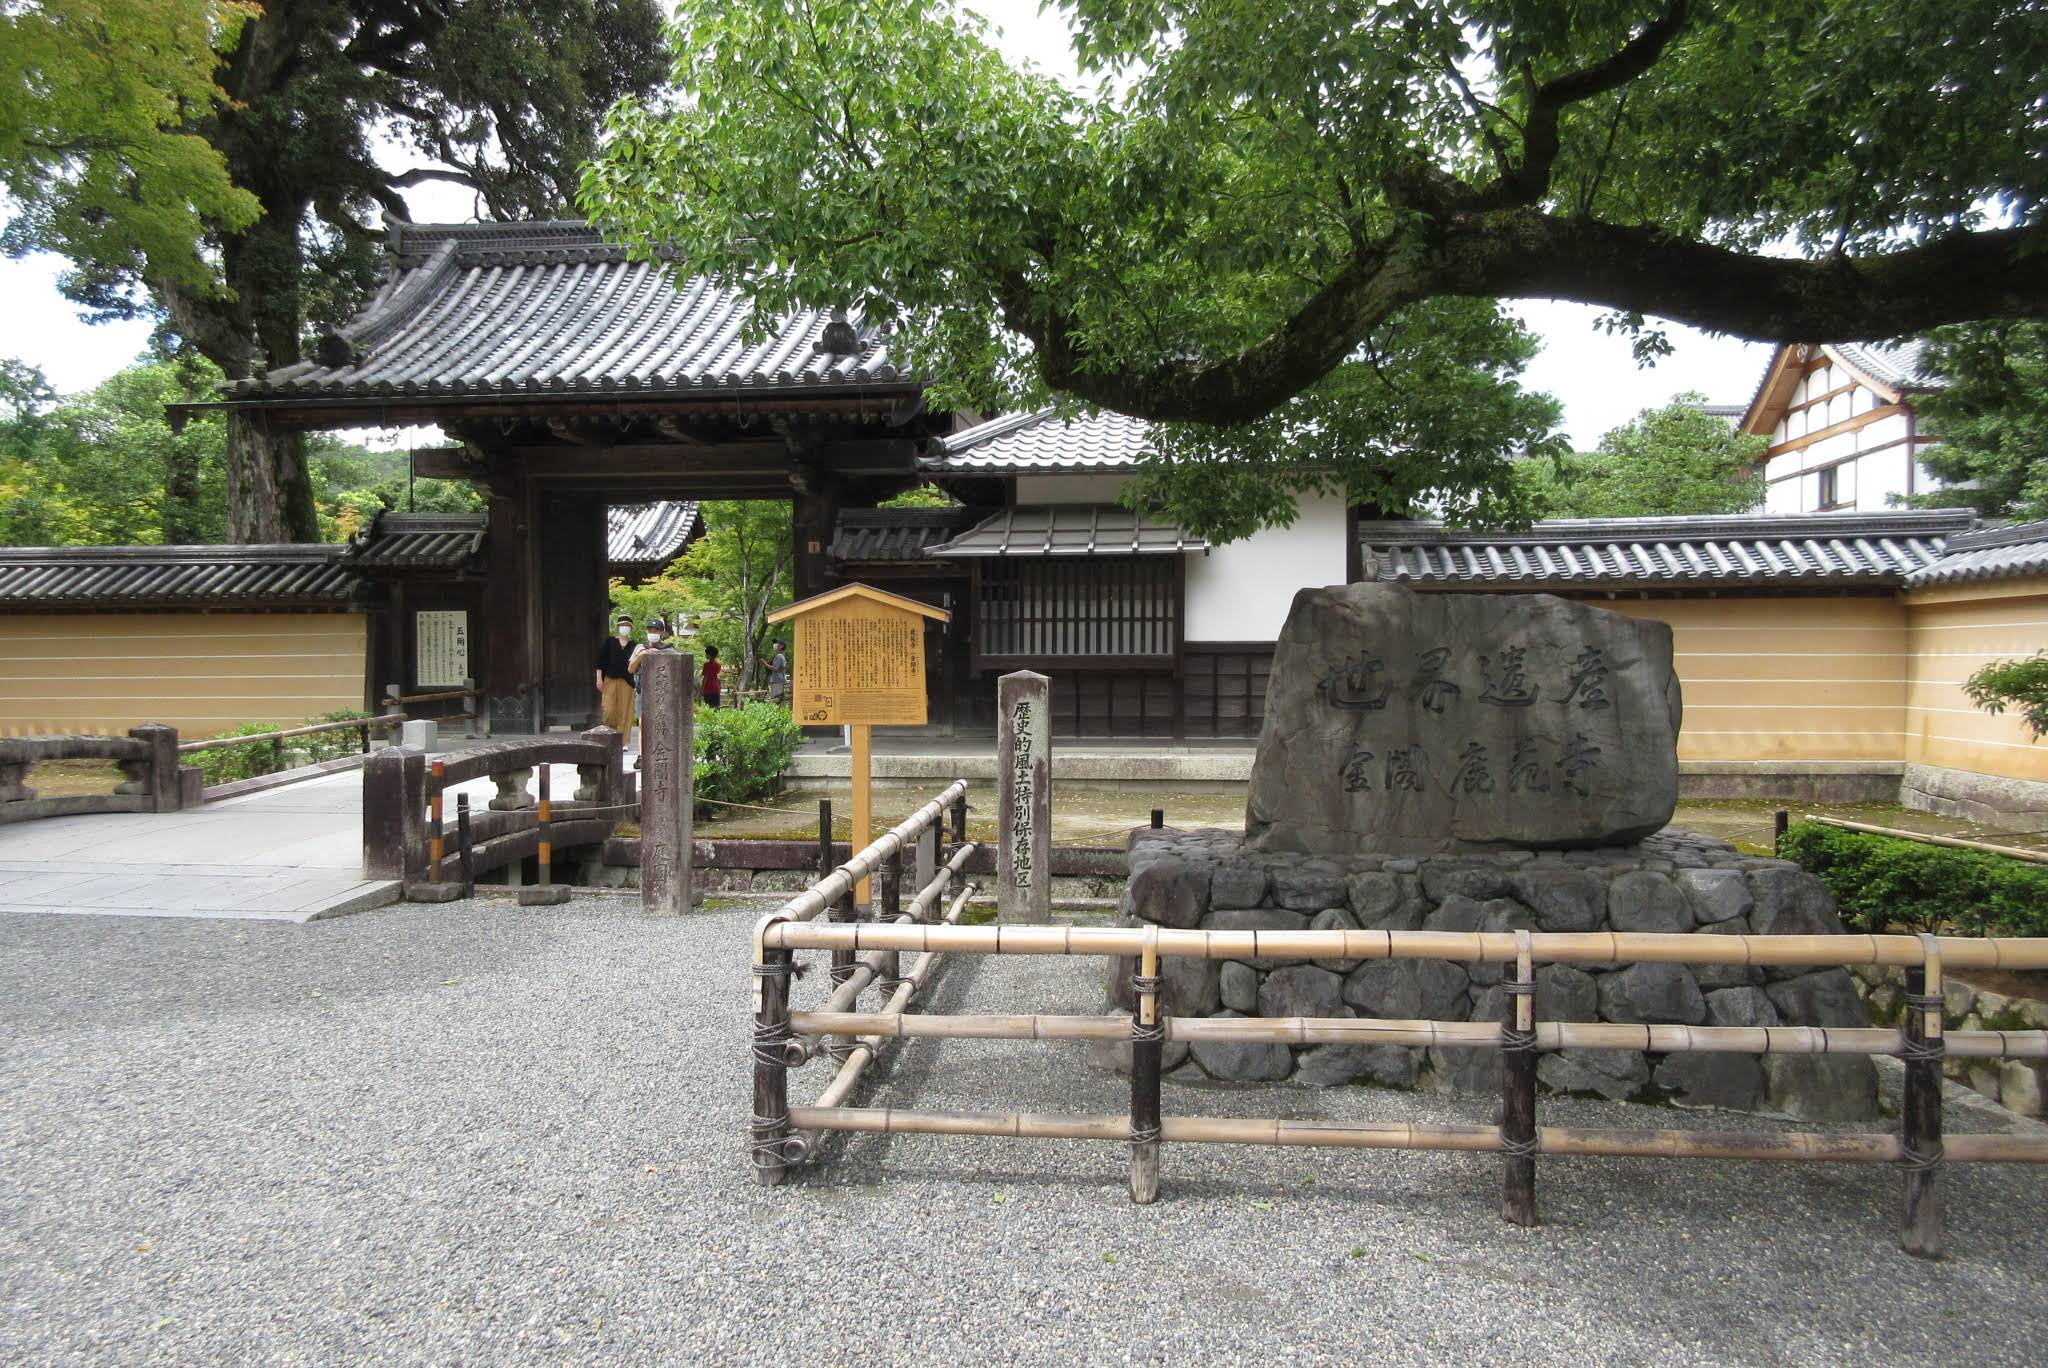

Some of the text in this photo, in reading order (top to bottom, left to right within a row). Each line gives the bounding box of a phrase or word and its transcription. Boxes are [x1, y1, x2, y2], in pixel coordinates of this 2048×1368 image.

[1317, 645, 1612, 714] 世界遺産
[1013, 702, 1033, 889] 歴史的風土特別保存地区
